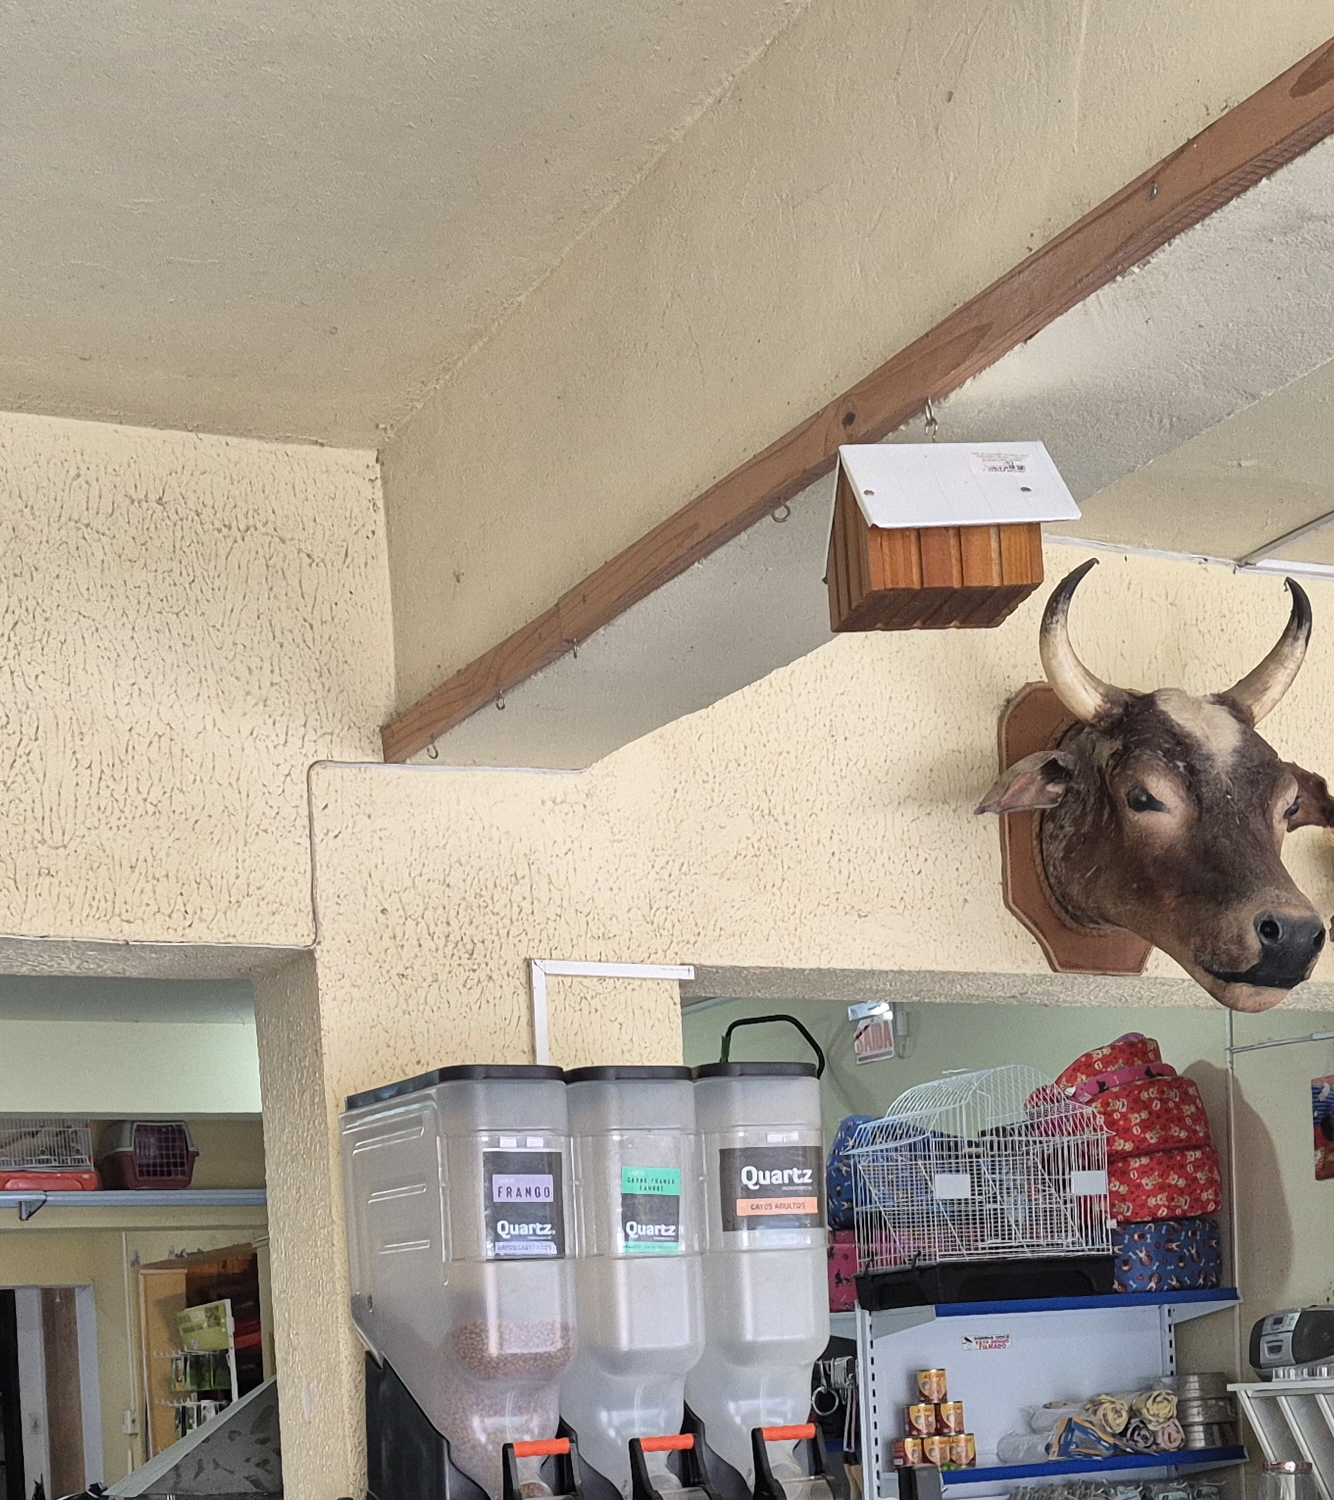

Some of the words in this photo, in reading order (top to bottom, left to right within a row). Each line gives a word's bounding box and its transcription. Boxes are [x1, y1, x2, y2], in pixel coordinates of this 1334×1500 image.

[740, 1165, 813, 1190] Quartz
[497, 1185, 551, 1199] FRANGO
[496, 1219, 553, 1239] Quartz
[625, 1220, 677, 1239] Quartz
